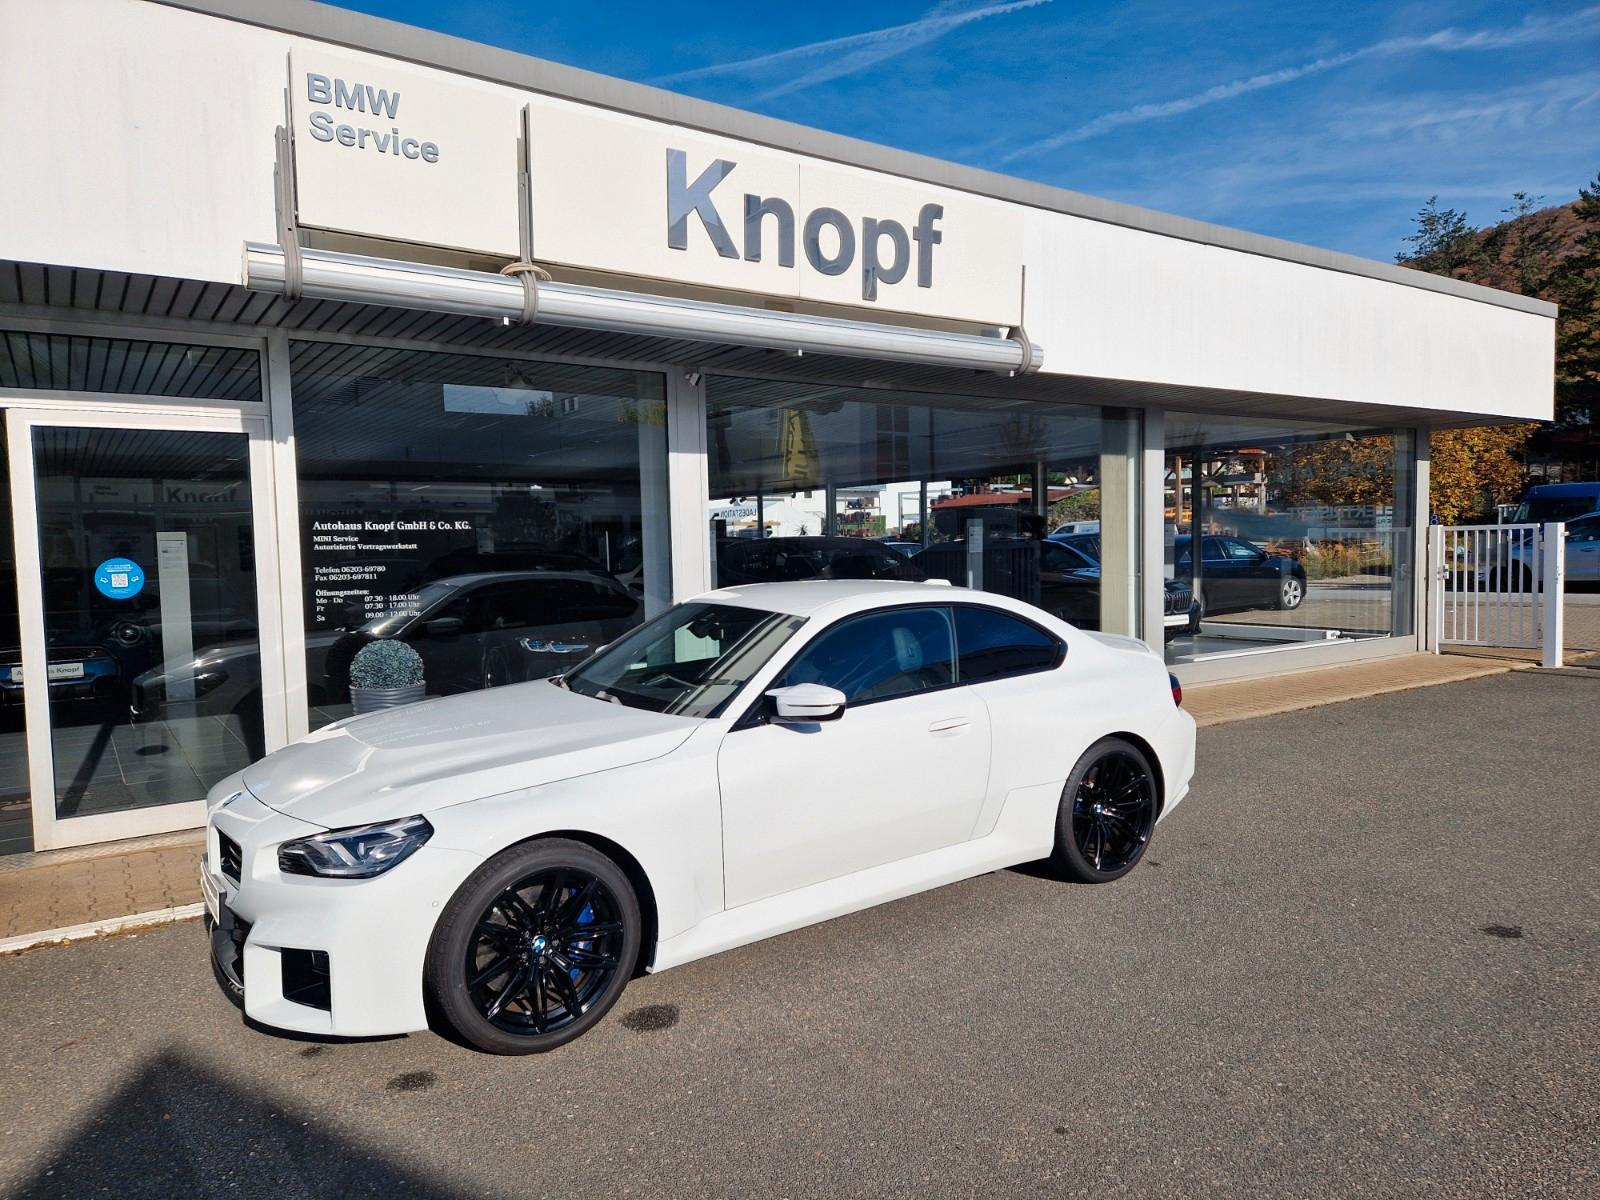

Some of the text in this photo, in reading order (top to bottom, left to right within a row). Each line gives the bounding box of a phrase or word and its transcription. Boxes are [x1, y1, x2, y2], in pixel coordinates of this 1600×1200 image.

[307, 72, 400, 119] BMW
[309, 111, 439, 163] Service
[666, 147, 944, 301] Knopf
[313, 521, 472, 532] Autohaus Knopf GmbH & Co. KG.
[357, 543, 418, 551] Vertragswerkstatt
[314, 566, 341, 574] Telefon
[315, 589, 370, 597] Öffnungszeiten:
[407, 593, 420, 601] Uhr
[56, 666, 79, 674] Knopf
